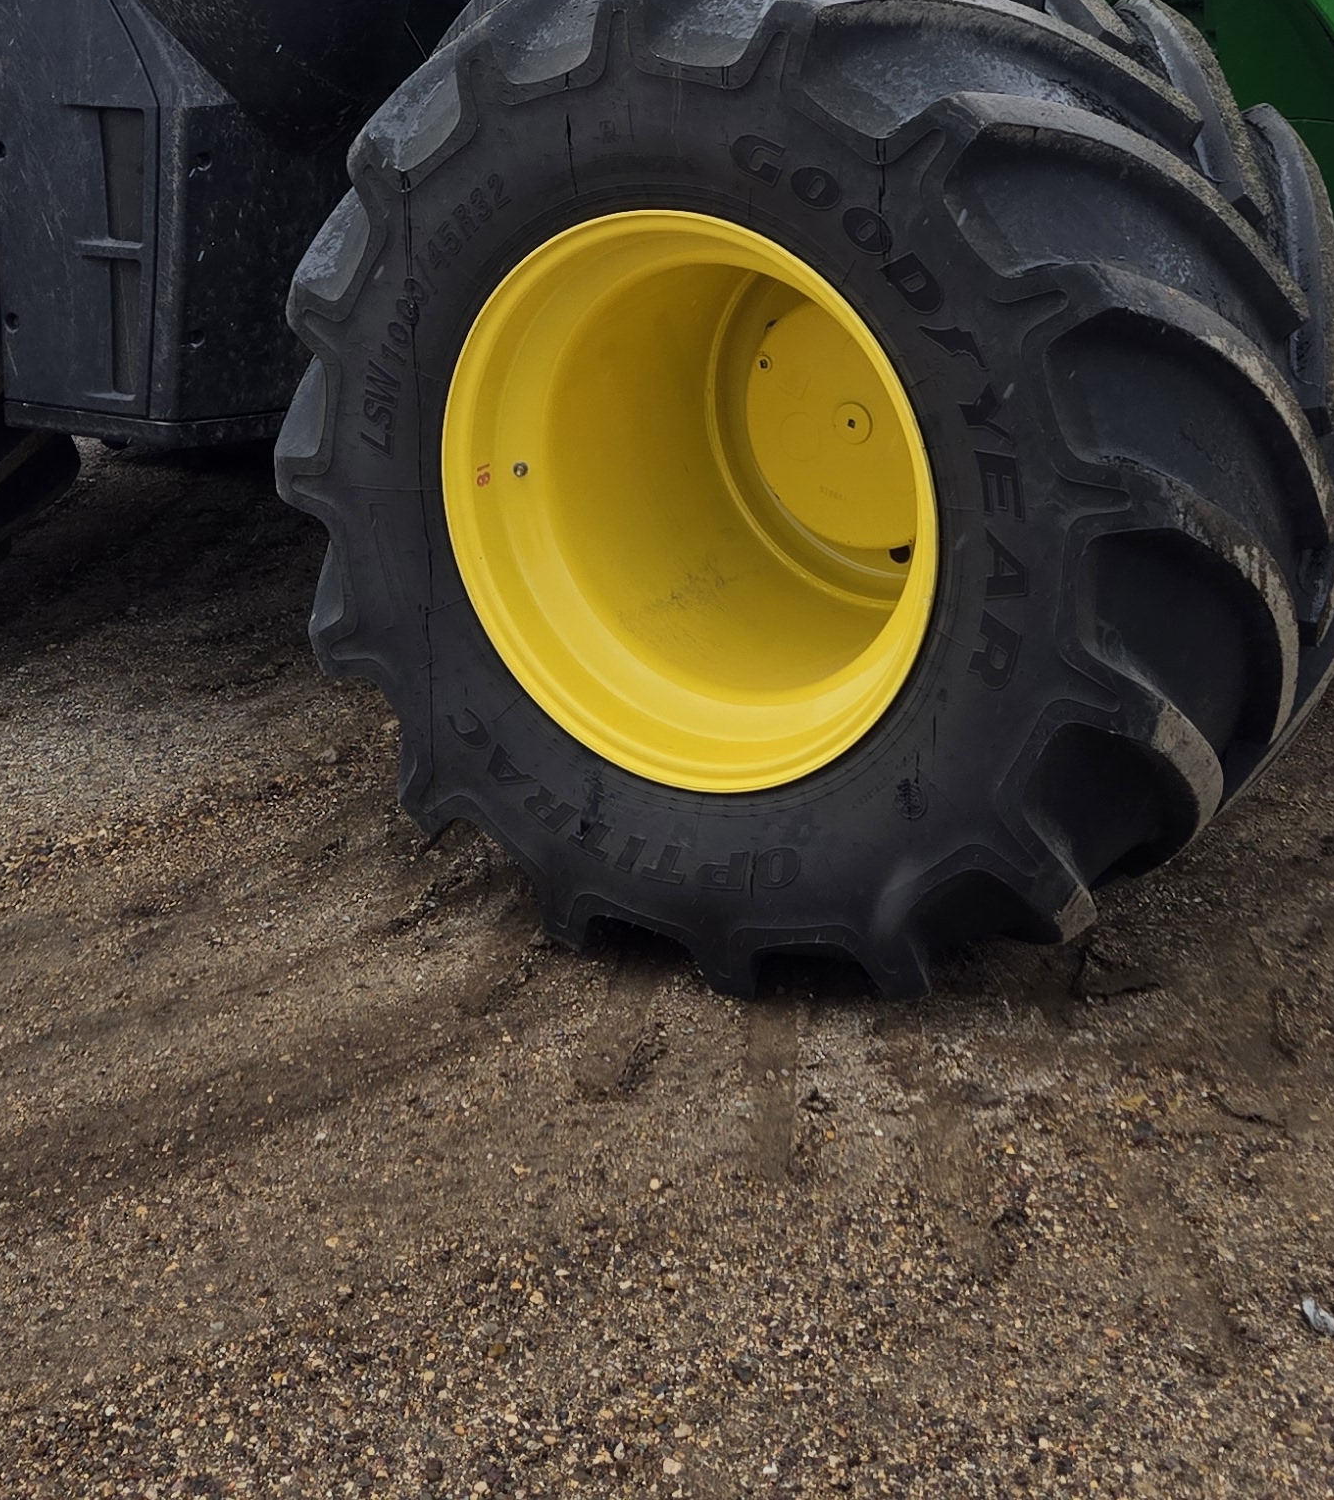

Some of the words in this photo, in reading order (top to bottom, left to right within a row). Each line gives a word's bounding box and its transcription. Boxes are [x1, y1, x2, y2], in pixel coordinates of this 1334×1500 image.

[358, 349, 401, 459] LSW
[729, 133, 1029, 690] GOODYEAR
[445, 706, 802, 891] OPTITRAC
